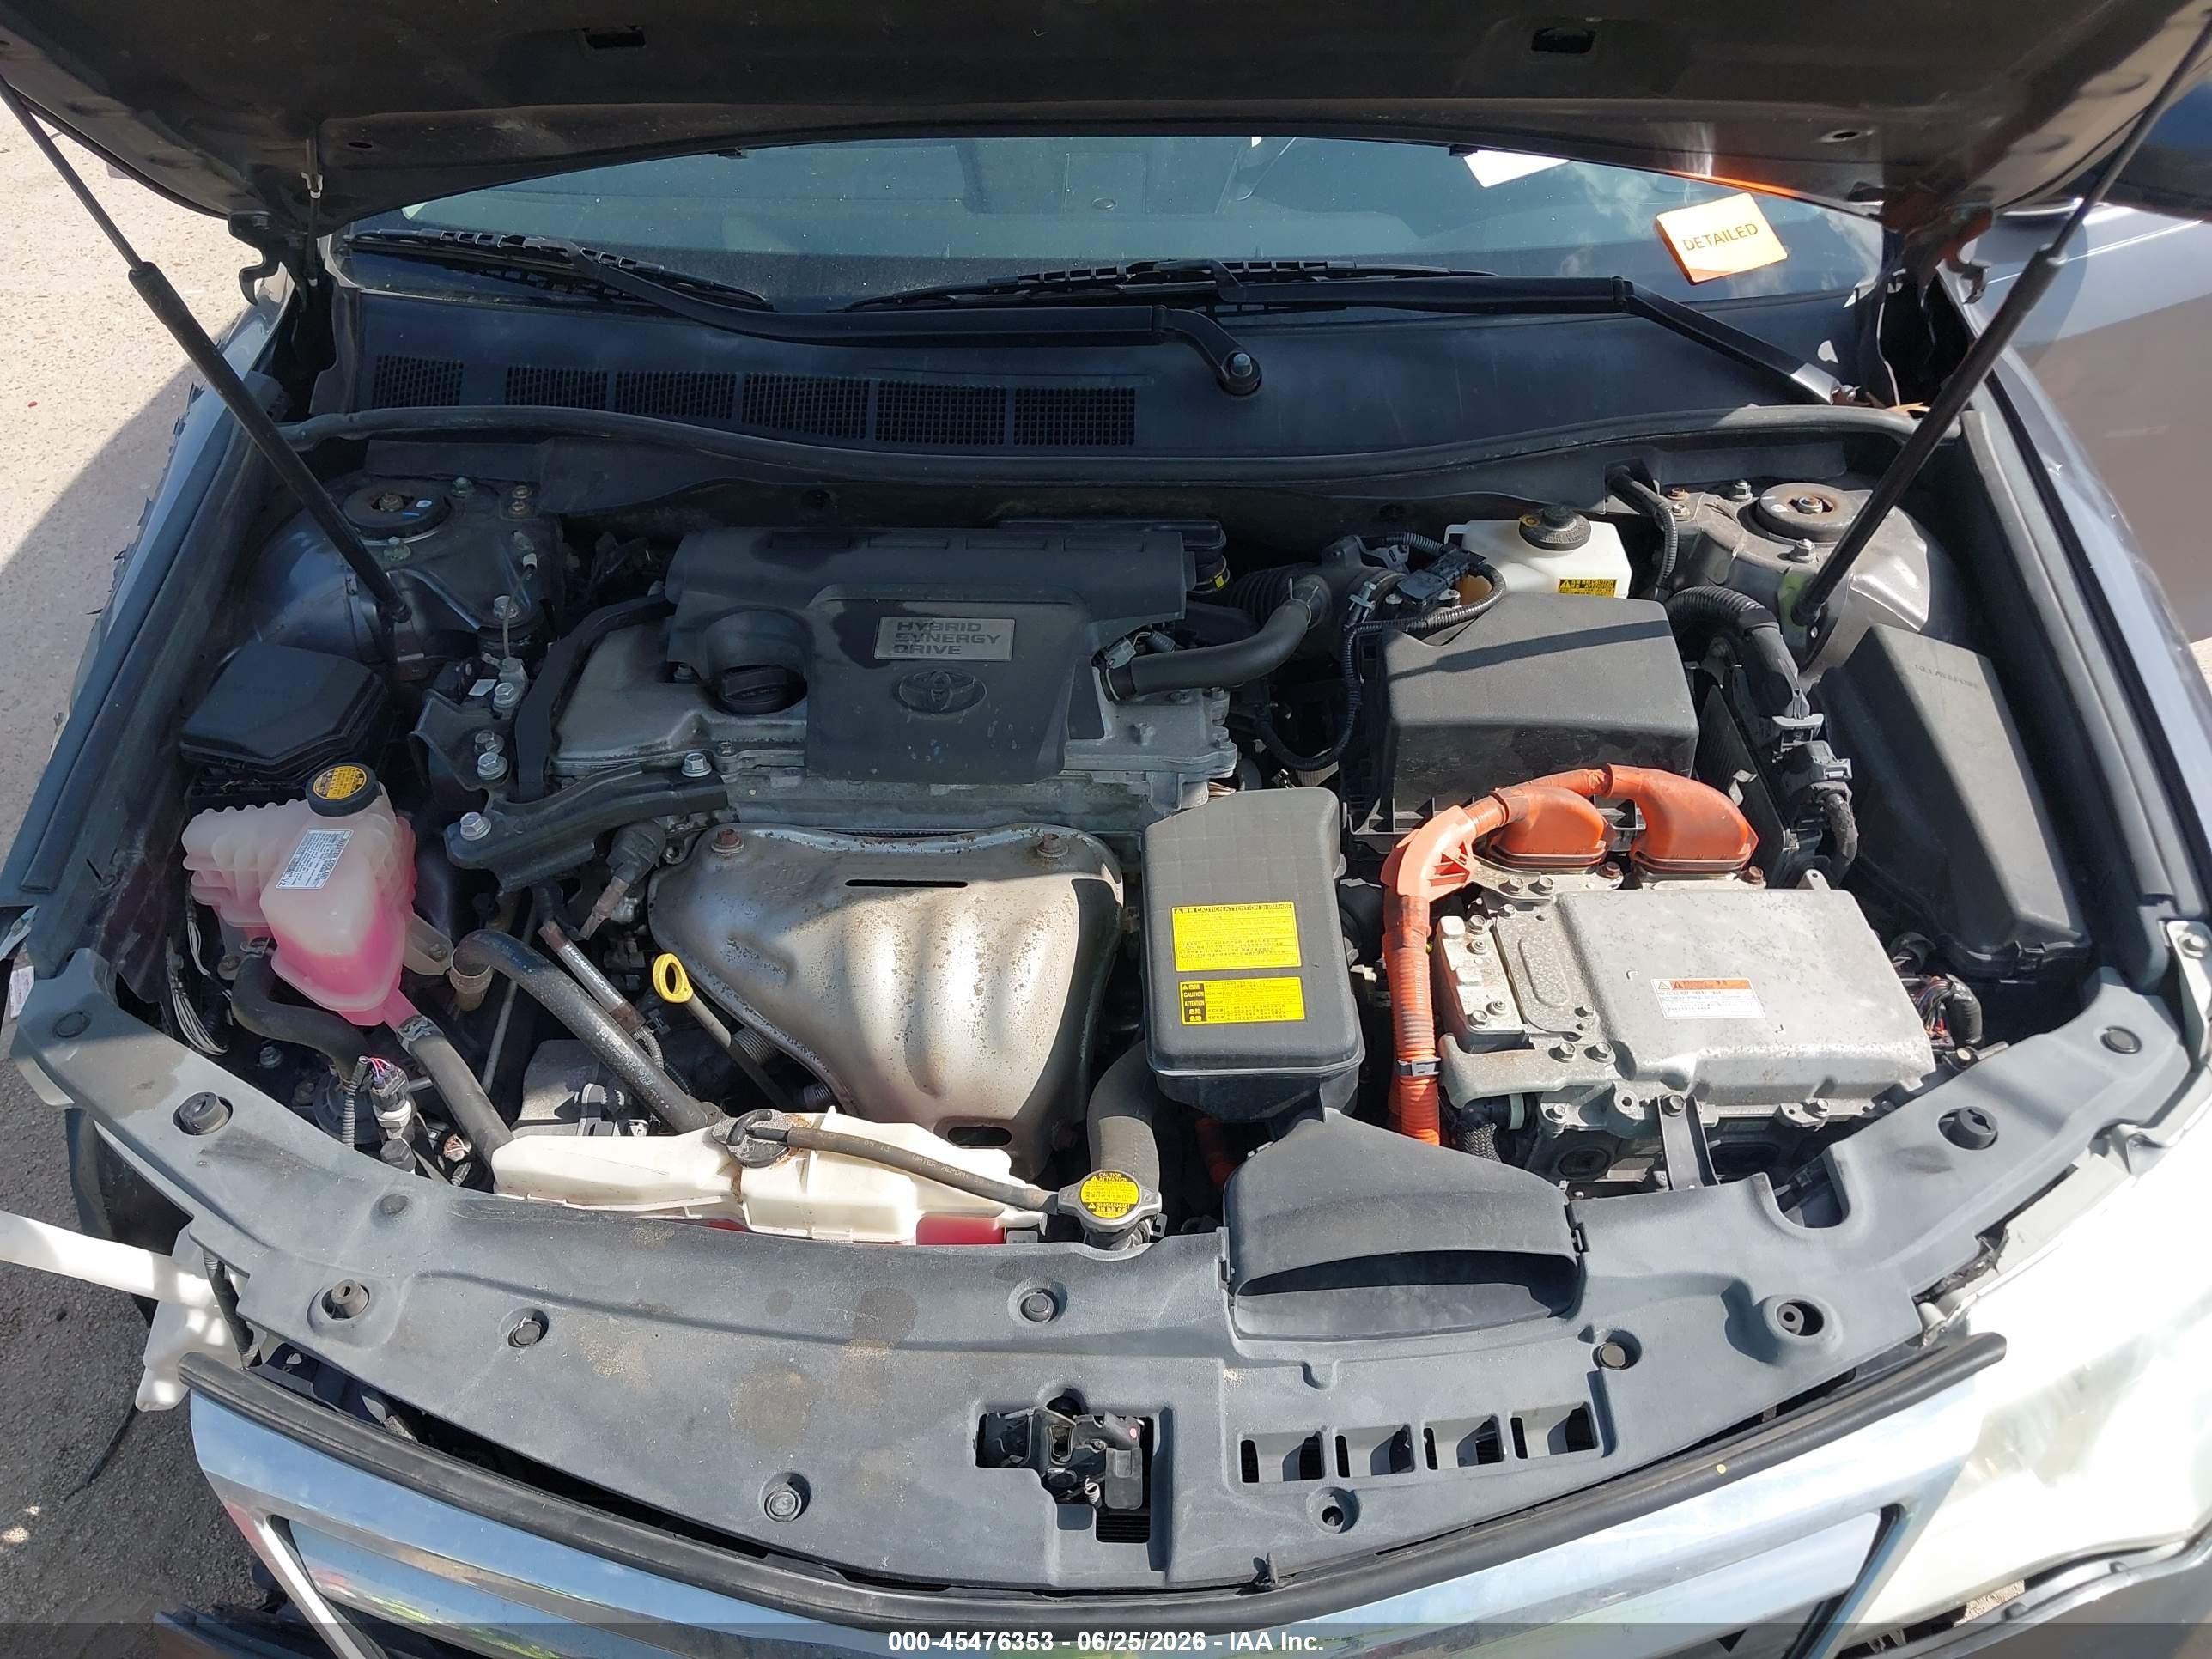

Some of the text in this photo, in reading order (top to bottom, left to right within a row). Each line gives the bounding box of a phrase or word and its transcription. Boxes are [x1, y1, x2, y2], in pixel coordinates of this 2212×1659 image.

[1682, 223, 1759, 251] DETAILED
[897, 621, 981, 632] HYBRID
[895, 633, 1001, 644] SYNERGY
[892, 644, 963, 655] DRIVE
[912, 1154, 937, 1168] WATER
